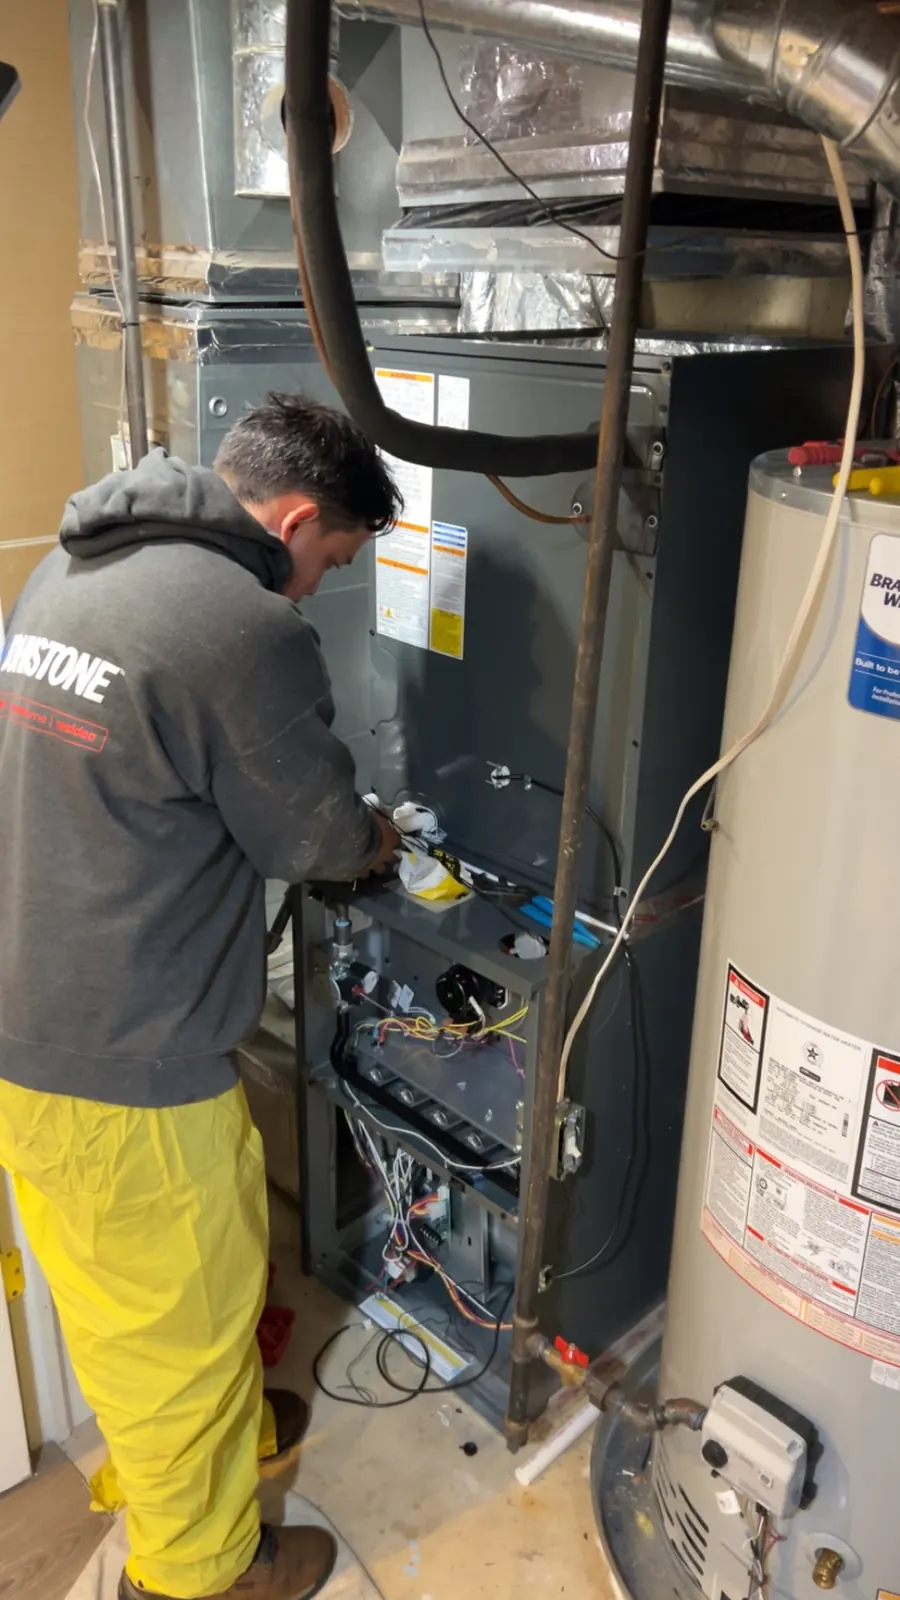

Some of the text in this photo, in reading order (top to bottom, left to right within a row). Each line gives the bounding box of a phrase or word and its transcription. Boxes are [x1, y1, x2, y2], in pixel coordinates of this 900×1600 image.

[884, 591, 900, 608] W
[855, 657, 900, 676] Built to be
